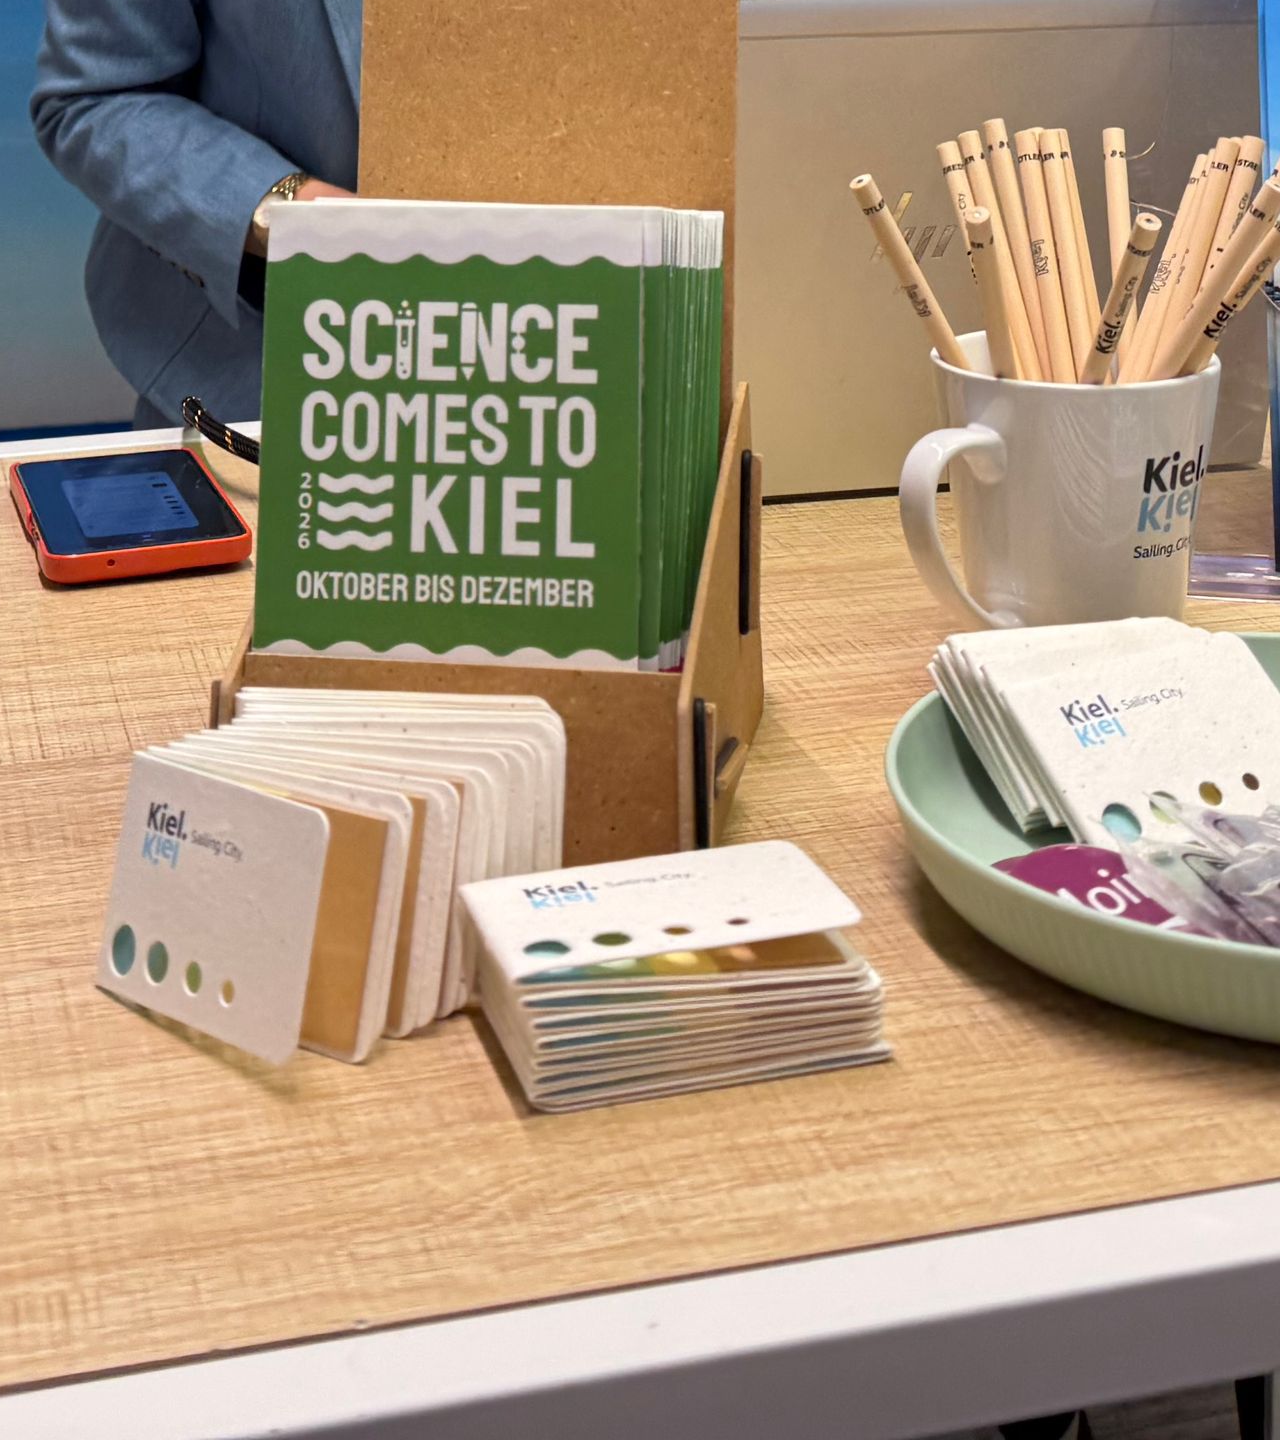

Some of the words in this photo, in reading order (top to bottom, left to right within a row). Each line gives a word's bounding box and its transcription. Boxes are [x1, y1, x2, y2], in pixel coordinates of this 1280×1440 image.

[1095, 318, 1121, 354] Kiel.
[1203, 301, 1237, 339] Kiel.
[302, 298, 599, 385] SCIENCE
[300, 390, 509, 466] COMES
[518, 395, 597, 469] TO
[1143, 445, 1205, 494] Kiel.
[410, 474, 596, 559] KIEL
[296, 570, 409, 602] OKTOBER
[415, 573, 455, 604] BIS
[461, 576, 595, 608] DEZEMBER
[1059, 694, 1119, 727] Kiel.
[147, 802, 187, 841] Kiel.
